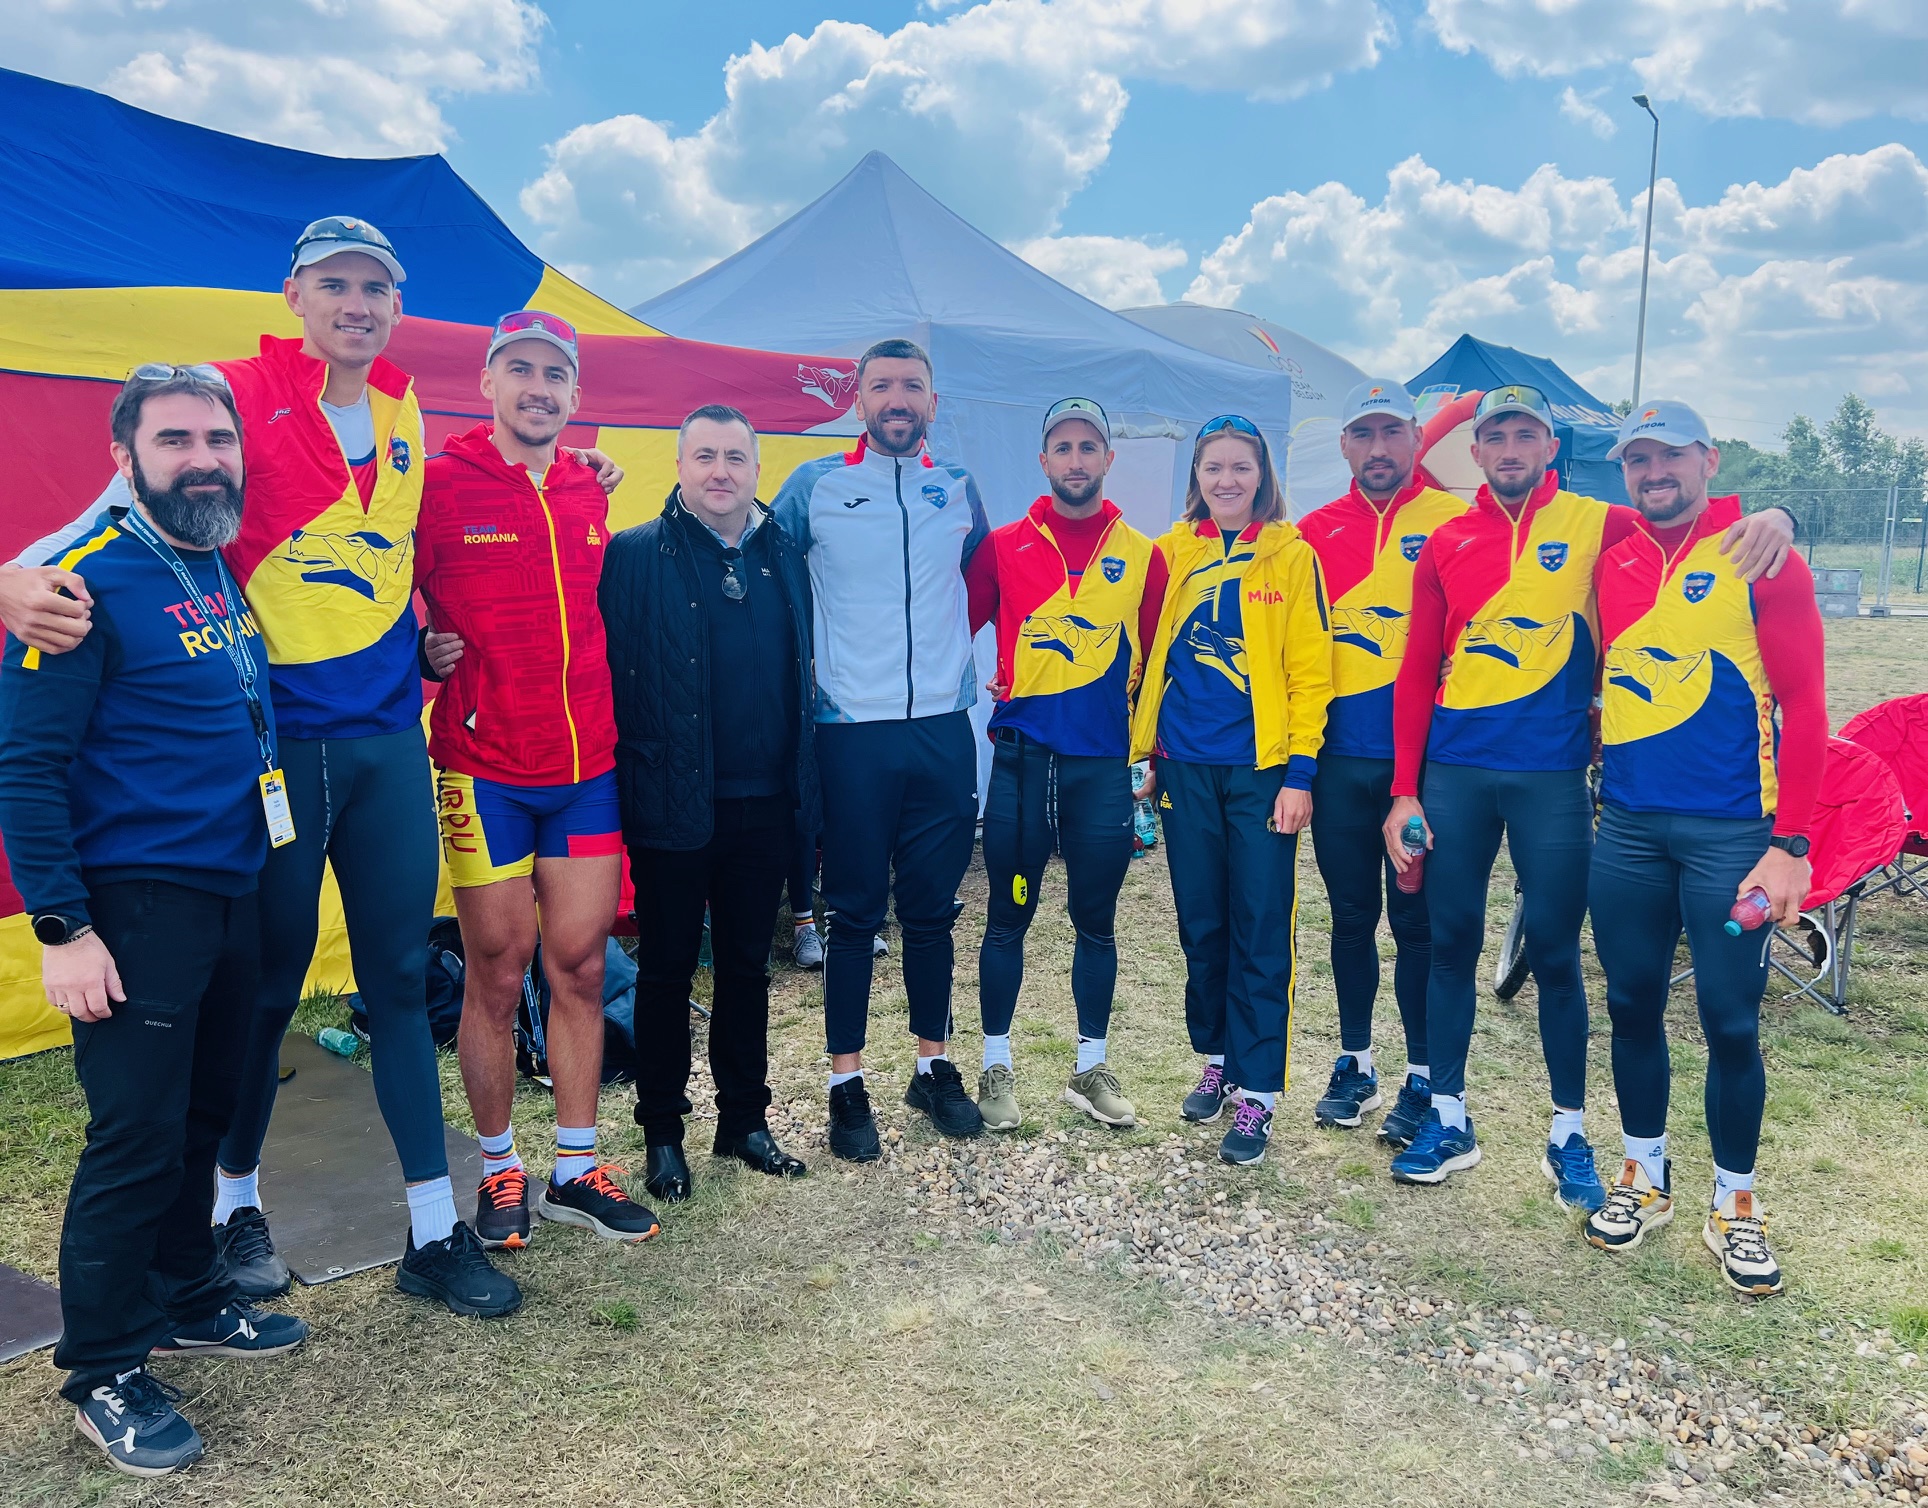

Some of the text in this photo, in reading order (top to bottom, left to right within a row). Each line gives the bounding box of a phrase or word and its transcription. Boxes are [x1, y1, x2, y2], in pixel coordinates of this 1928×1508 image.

[1361, 398, 1390, 408] PETROM
[1631, 422, 1665, 436] PETROM
[463, 525, 498, 535] TEAM
[463, 533, 519, 545] ROMANIA
[443, 788, 478, 854] ROU
[144, 1019, 172, 1028] QUECHUA
